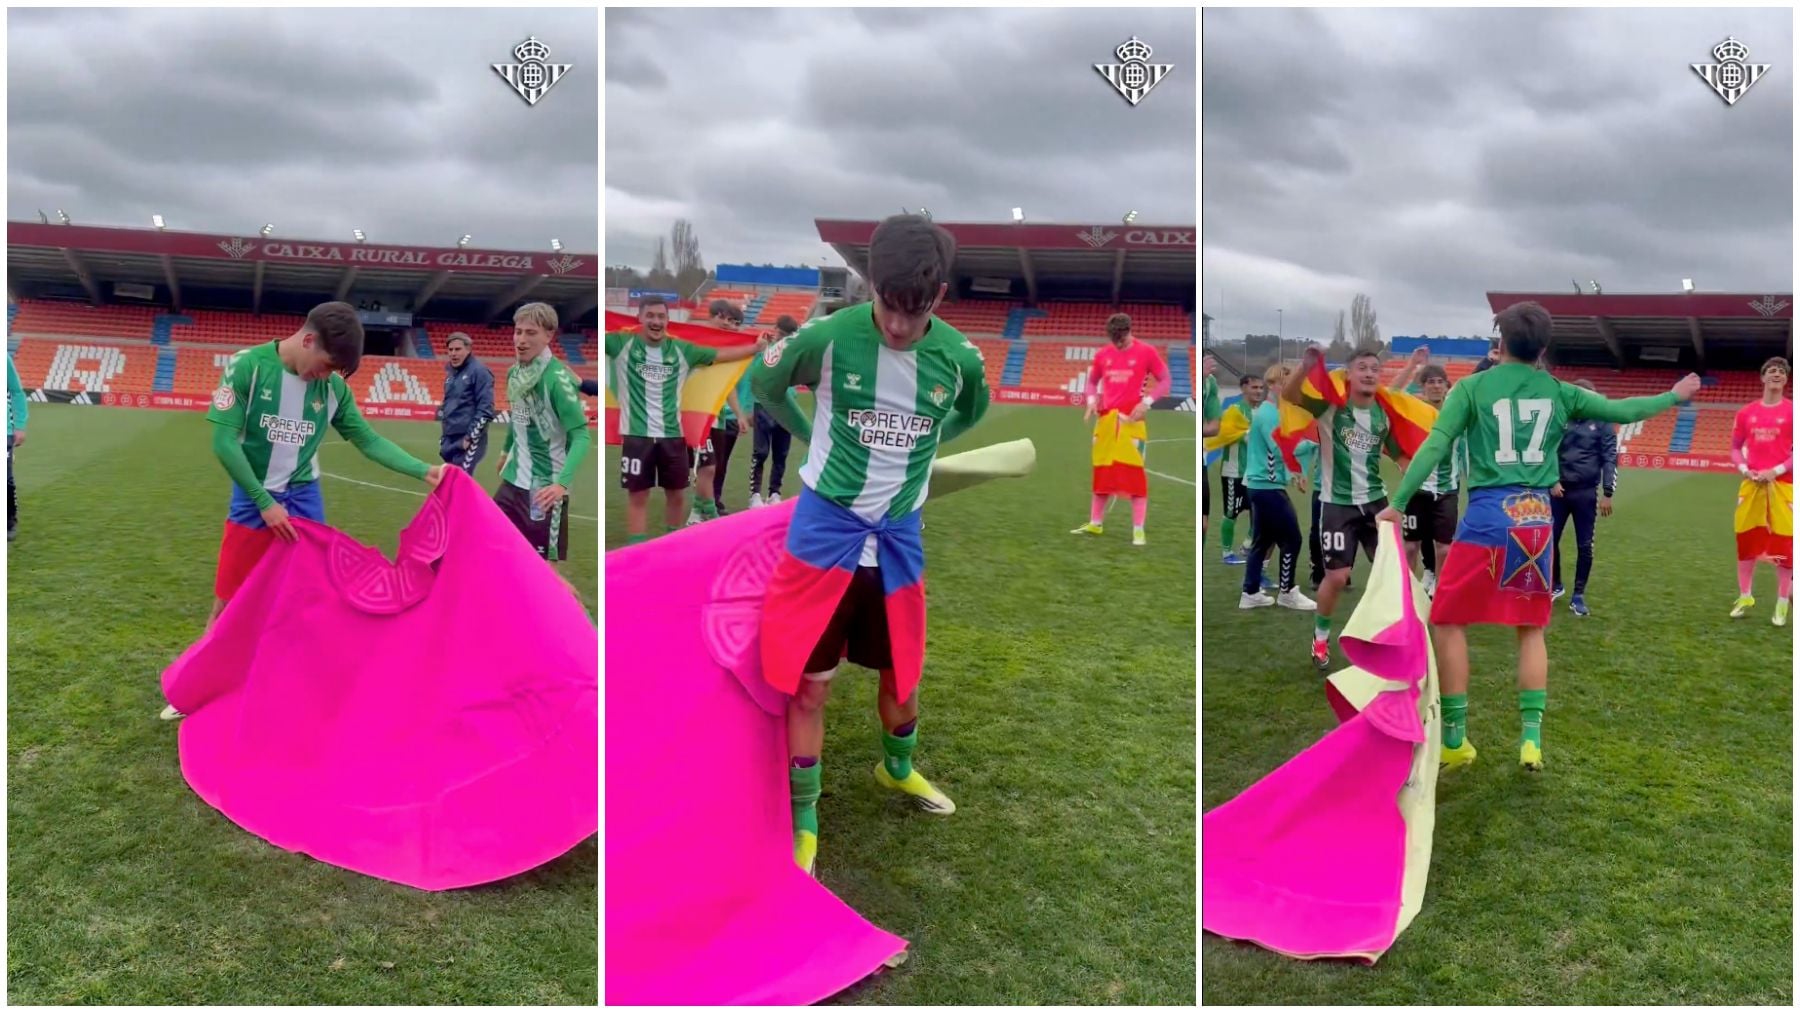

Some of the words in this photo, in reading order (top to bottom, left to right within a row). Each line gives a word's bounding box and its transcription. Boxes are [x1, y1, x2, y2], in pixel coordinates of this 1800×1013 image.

[262, 243, 344, 261] CAIXA
[350, 247, 430, 266] RURAL
[435, 252, 534, 270] GALEGA
[636, 363, 673, 374] FOREVER
[262, 415, 314, 433] FOREVER
[850, 411, 932, 432] FOREVER
[1492, 398, 1554, 465] 17
[269, 429, 305, 444] GREEN
[861, 429, 918, 448] GREEN
[621, 456, 642, 476] 30
[1322, 531, 1345, 551] 30
